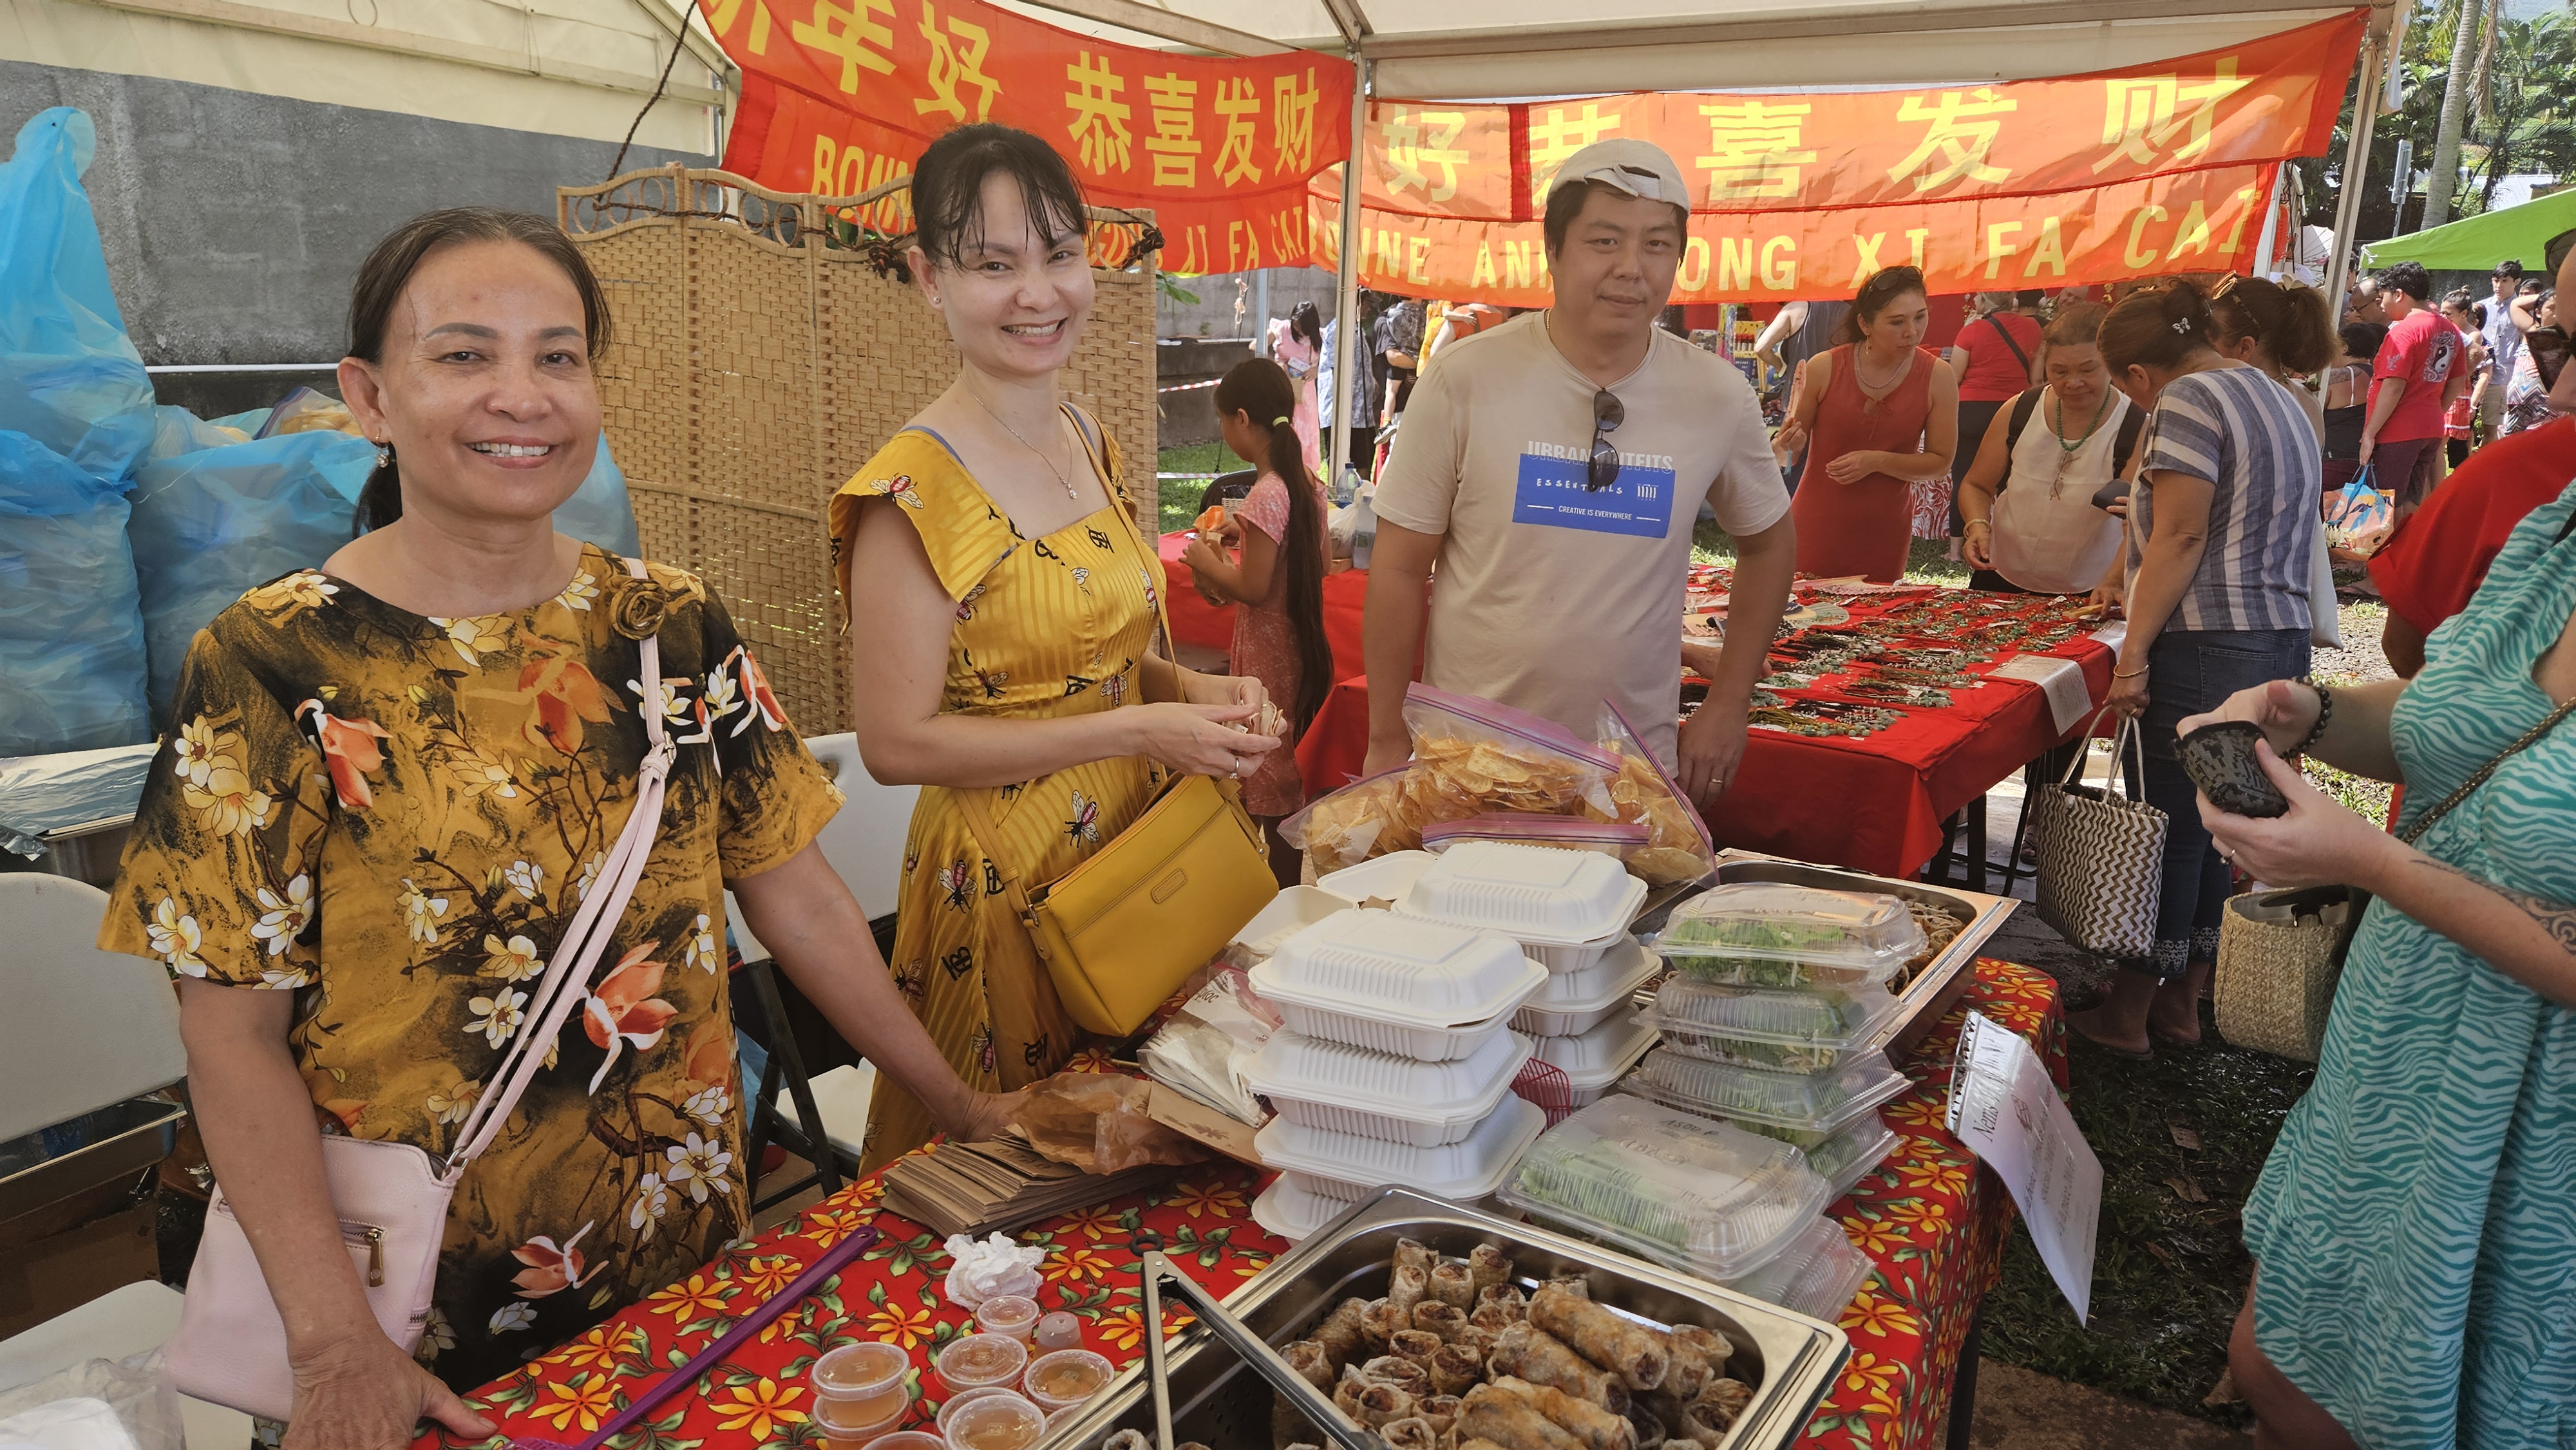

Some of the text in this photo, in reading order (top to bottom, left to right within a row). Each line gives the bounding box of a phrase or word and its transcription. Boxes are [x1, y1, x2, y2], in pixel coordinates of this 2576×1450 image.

[1065, 51, 1319, 187] 恭喜发财
[1229, 220, 1259, 273] FA
[1271, 206, 1305, 264] CAI
[1983, 215, 2066, 279] FA
[2124, 189, 2262, 268] CAI
[1537, 478, 1623, 494] ESSENTALS
[1558, 505, 1586, 516] CREATIVE
[1595, 510, 1633, 521] EVERYWHERE
